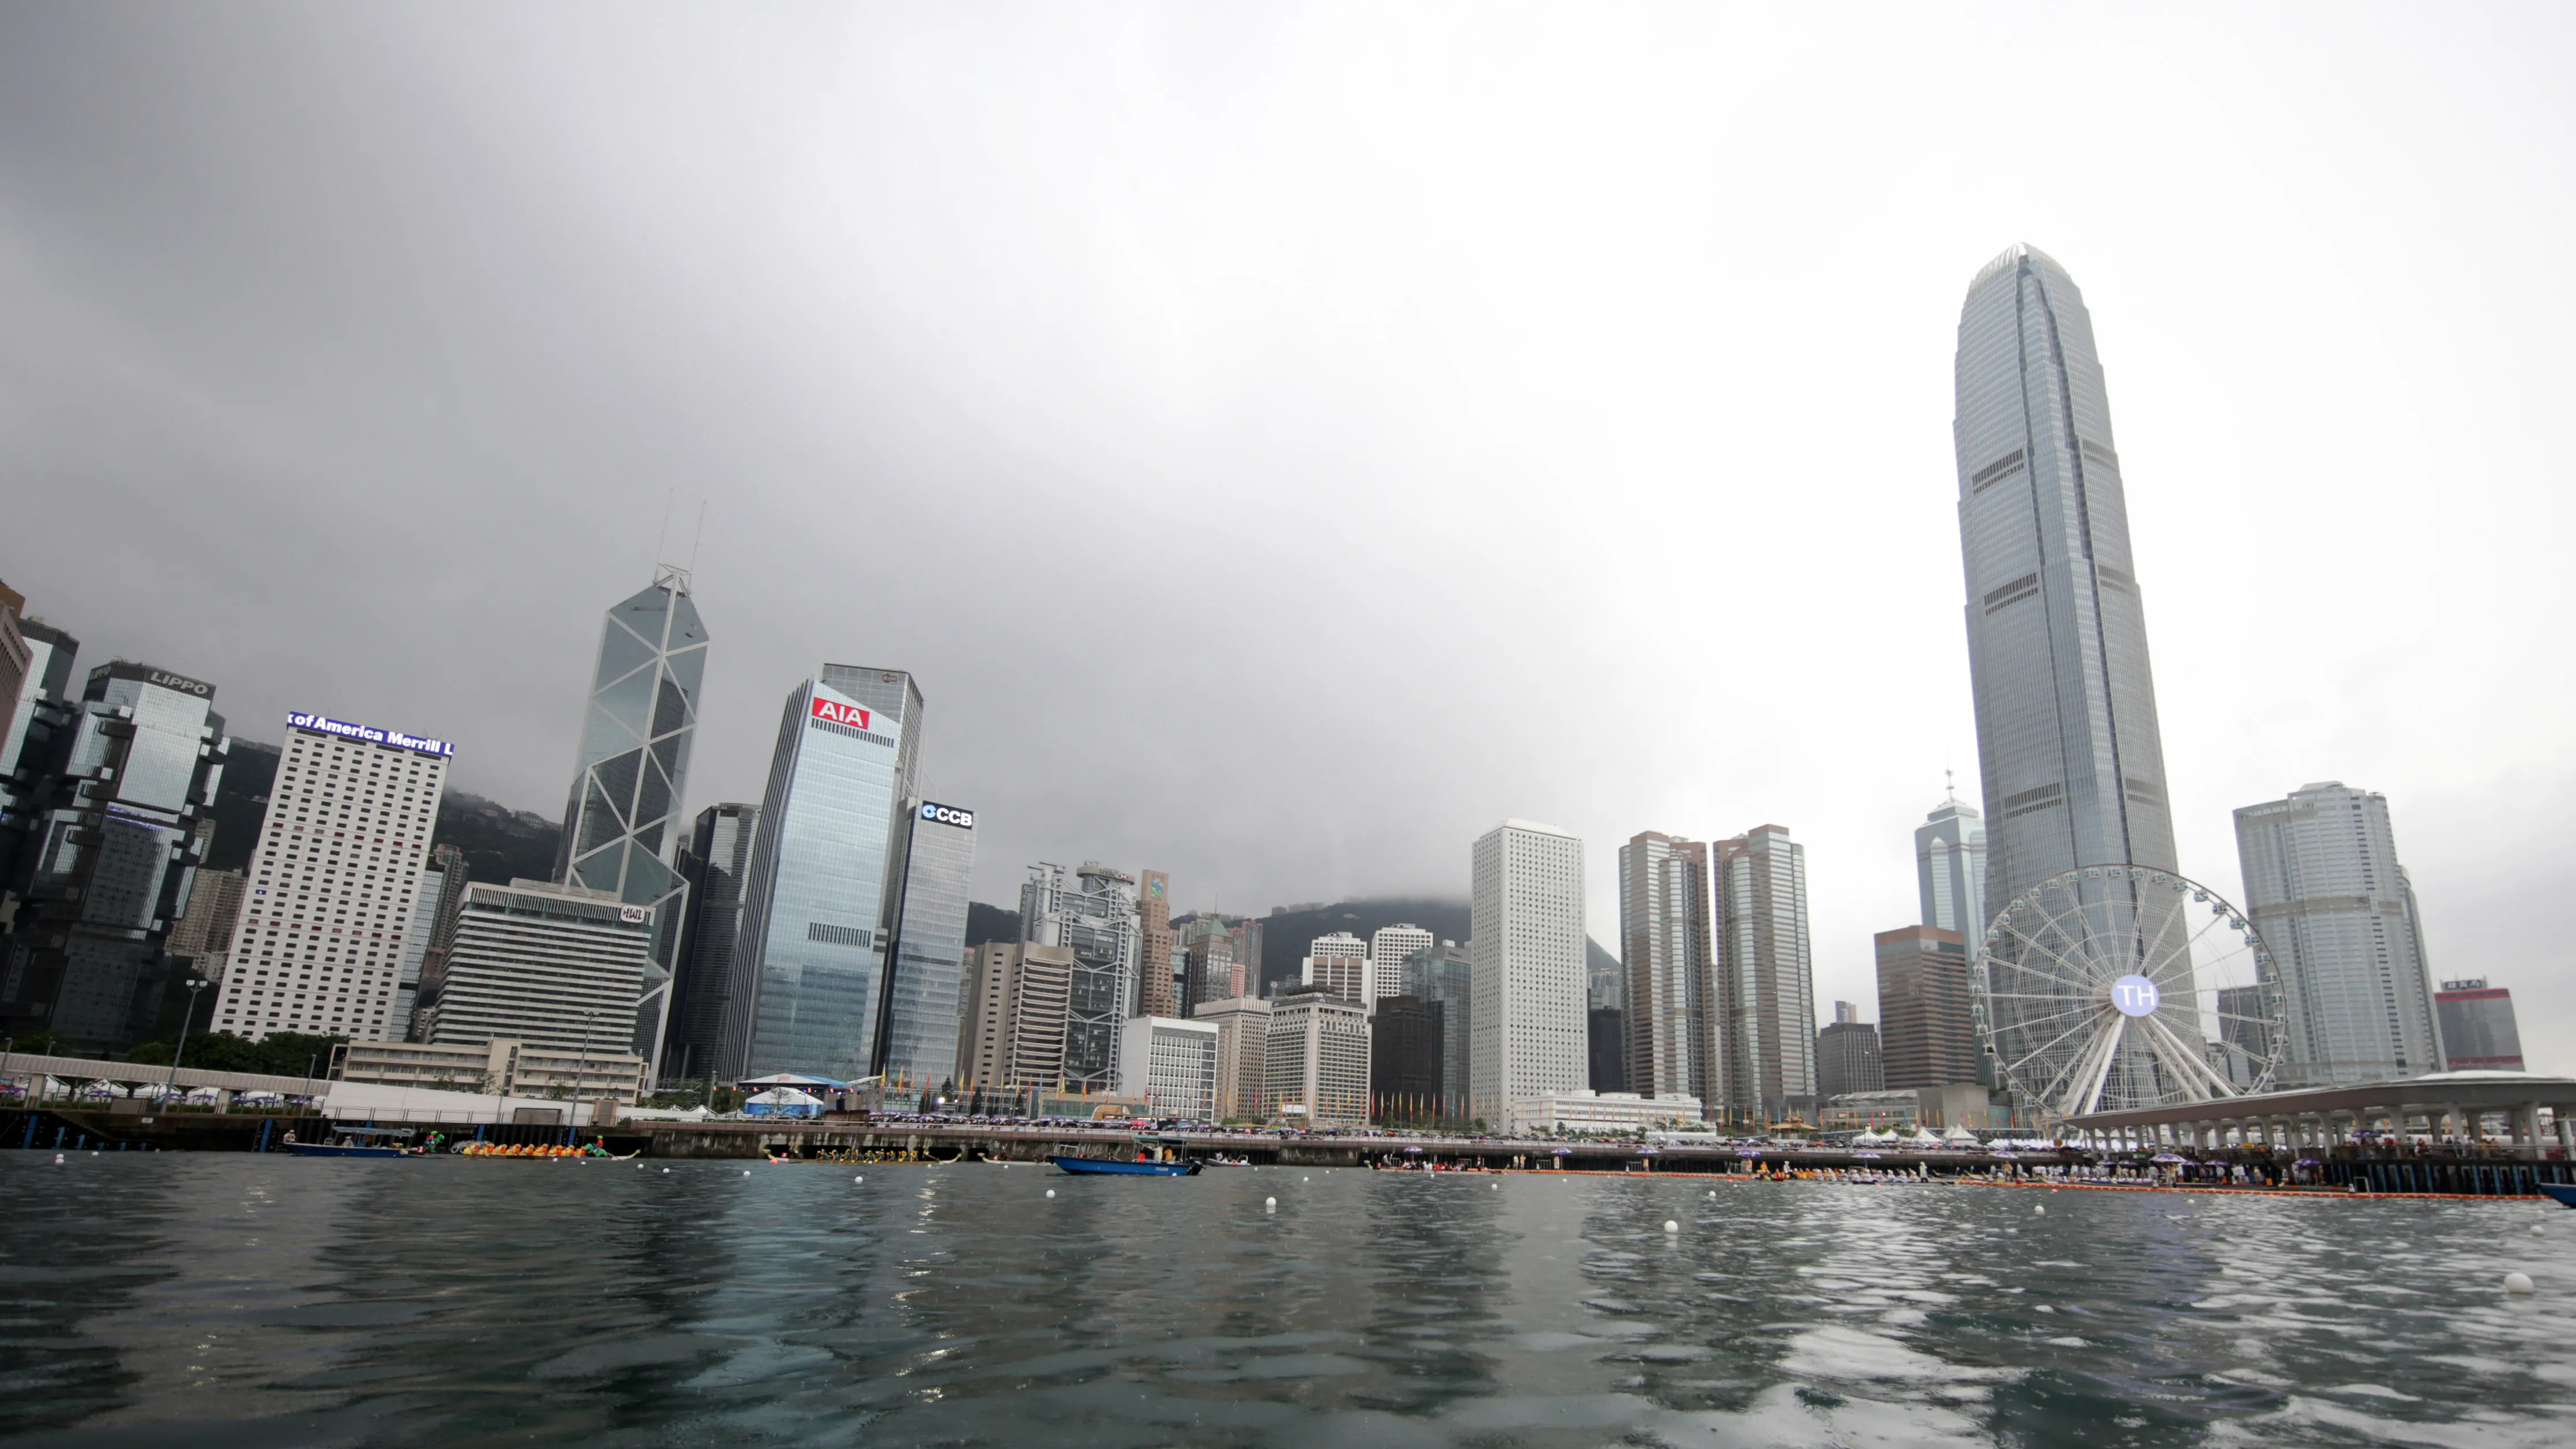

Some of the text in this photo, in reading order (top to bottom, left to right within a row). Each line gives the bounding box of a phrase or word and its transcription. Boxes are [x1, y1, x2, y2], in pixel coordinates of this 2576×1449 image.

[151, 671, 208, 695] LIPPO
[818, 701, 863, 727] AIA
[294, 715, 315, 727] of
[313, 718, 384, 741] America
[387, 731, 441, 753] Merrill
[936, 808, 972, 827] CCB
[622, 908, 642, 919] HWL
[2116, 985, 2156, 1007] TH
